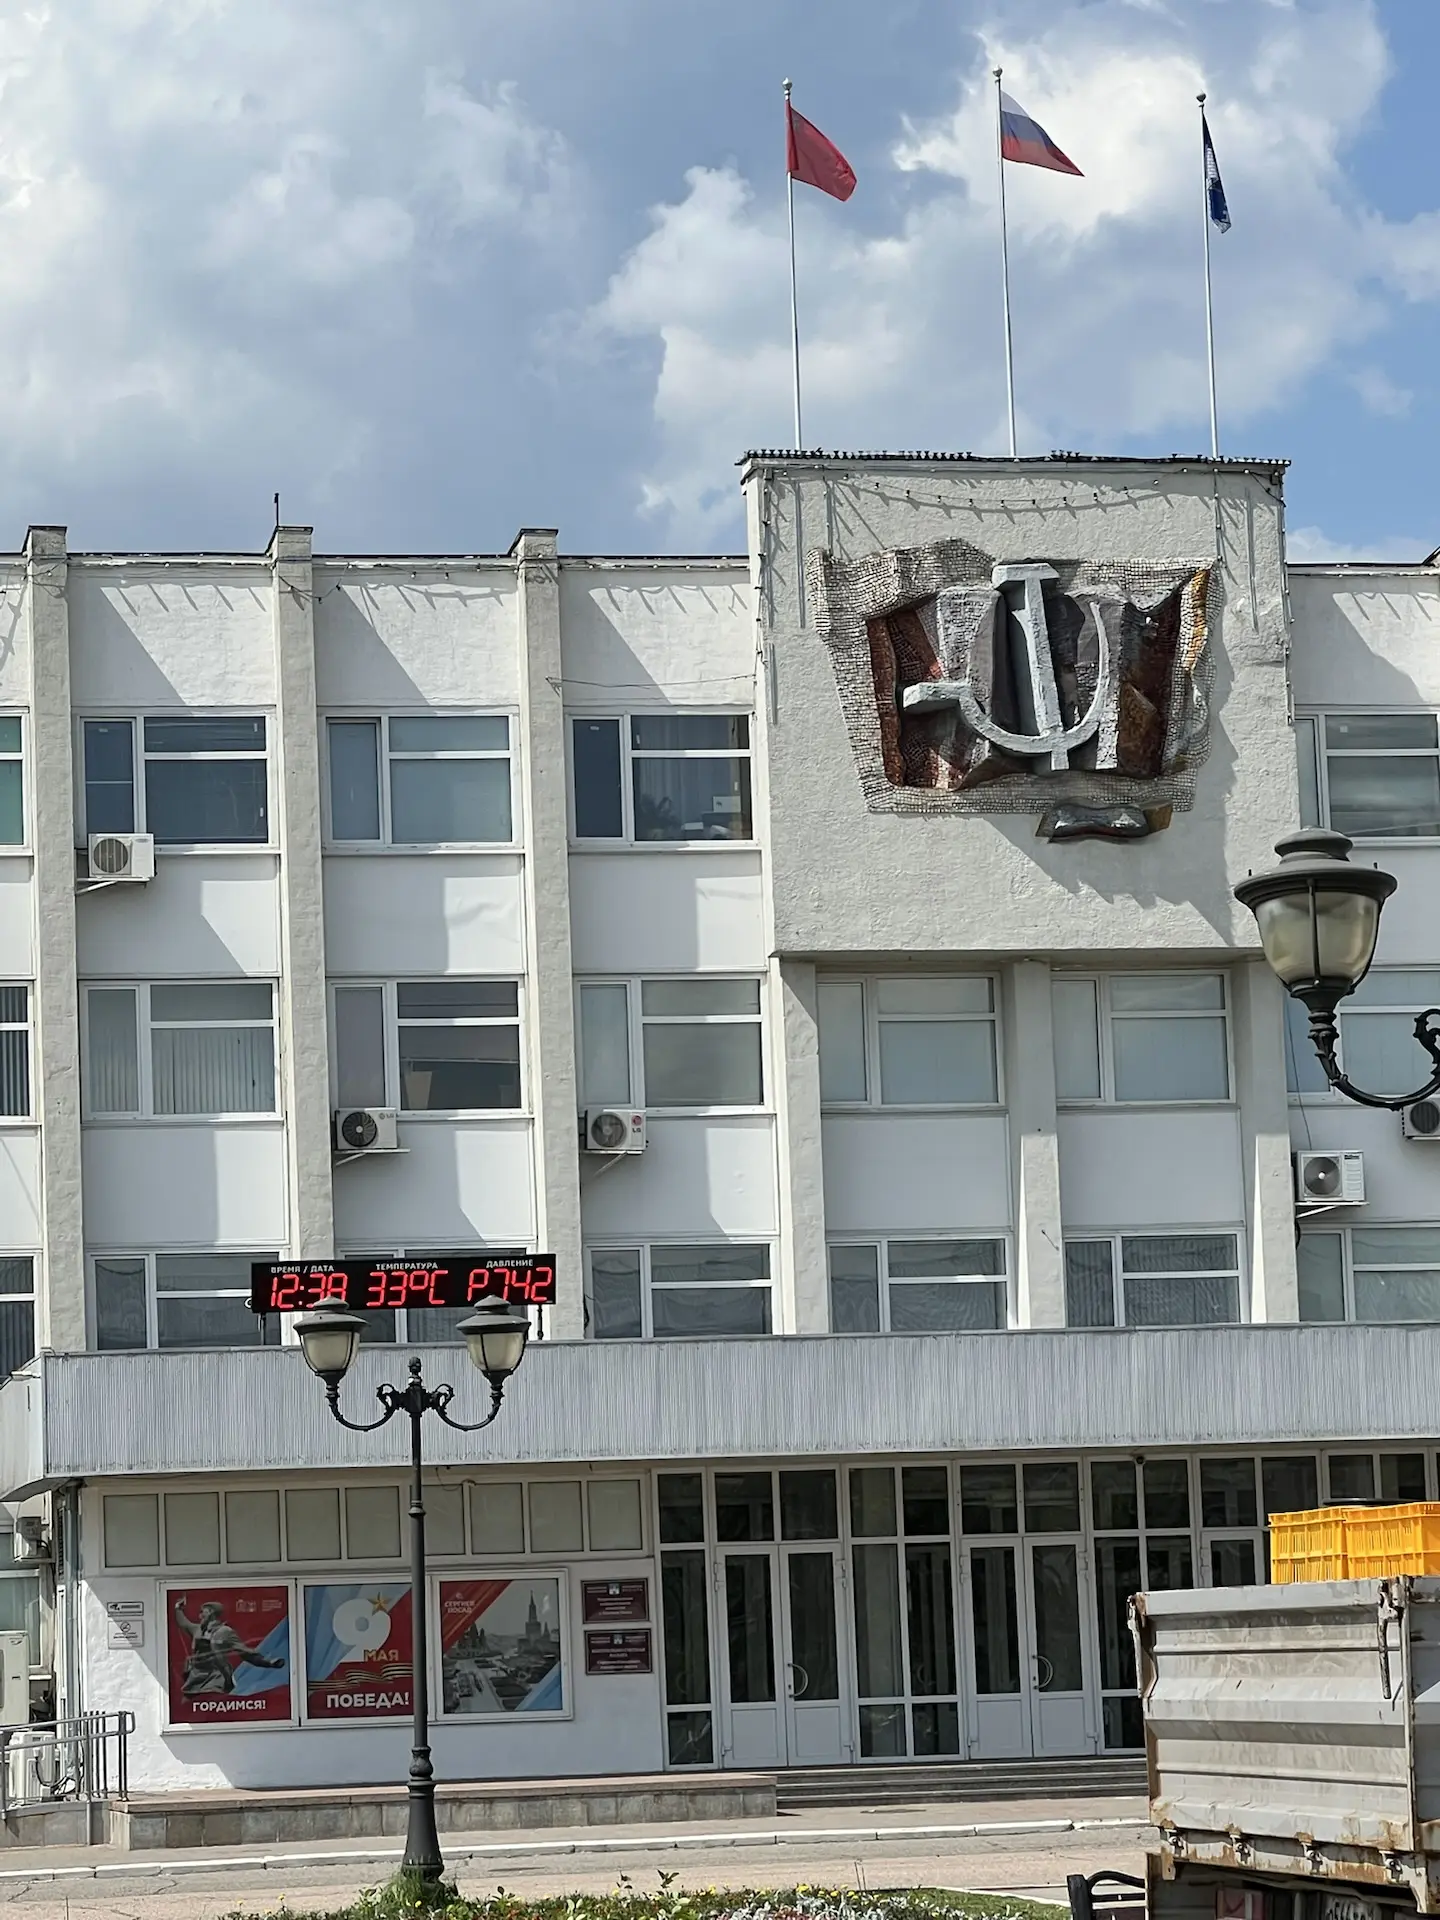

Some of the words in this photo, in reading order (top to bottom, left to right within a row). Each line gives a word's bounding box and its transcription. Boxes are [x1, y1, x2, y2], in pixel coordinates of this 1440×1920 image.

[376, 1262, 438, 1270] ТЕМПЕРАТУРА
[486, 1259, 533, 1268] ДАВЛЕНИЕ
[271, 1273, 348, 1308] 12:38
[363, 1649, 399, 1662] МАЯ
[192, 1700, 266, 1712] ГОРДИМСЯ!
[326, 1692, 409, 1708] ПОБЕДА!
